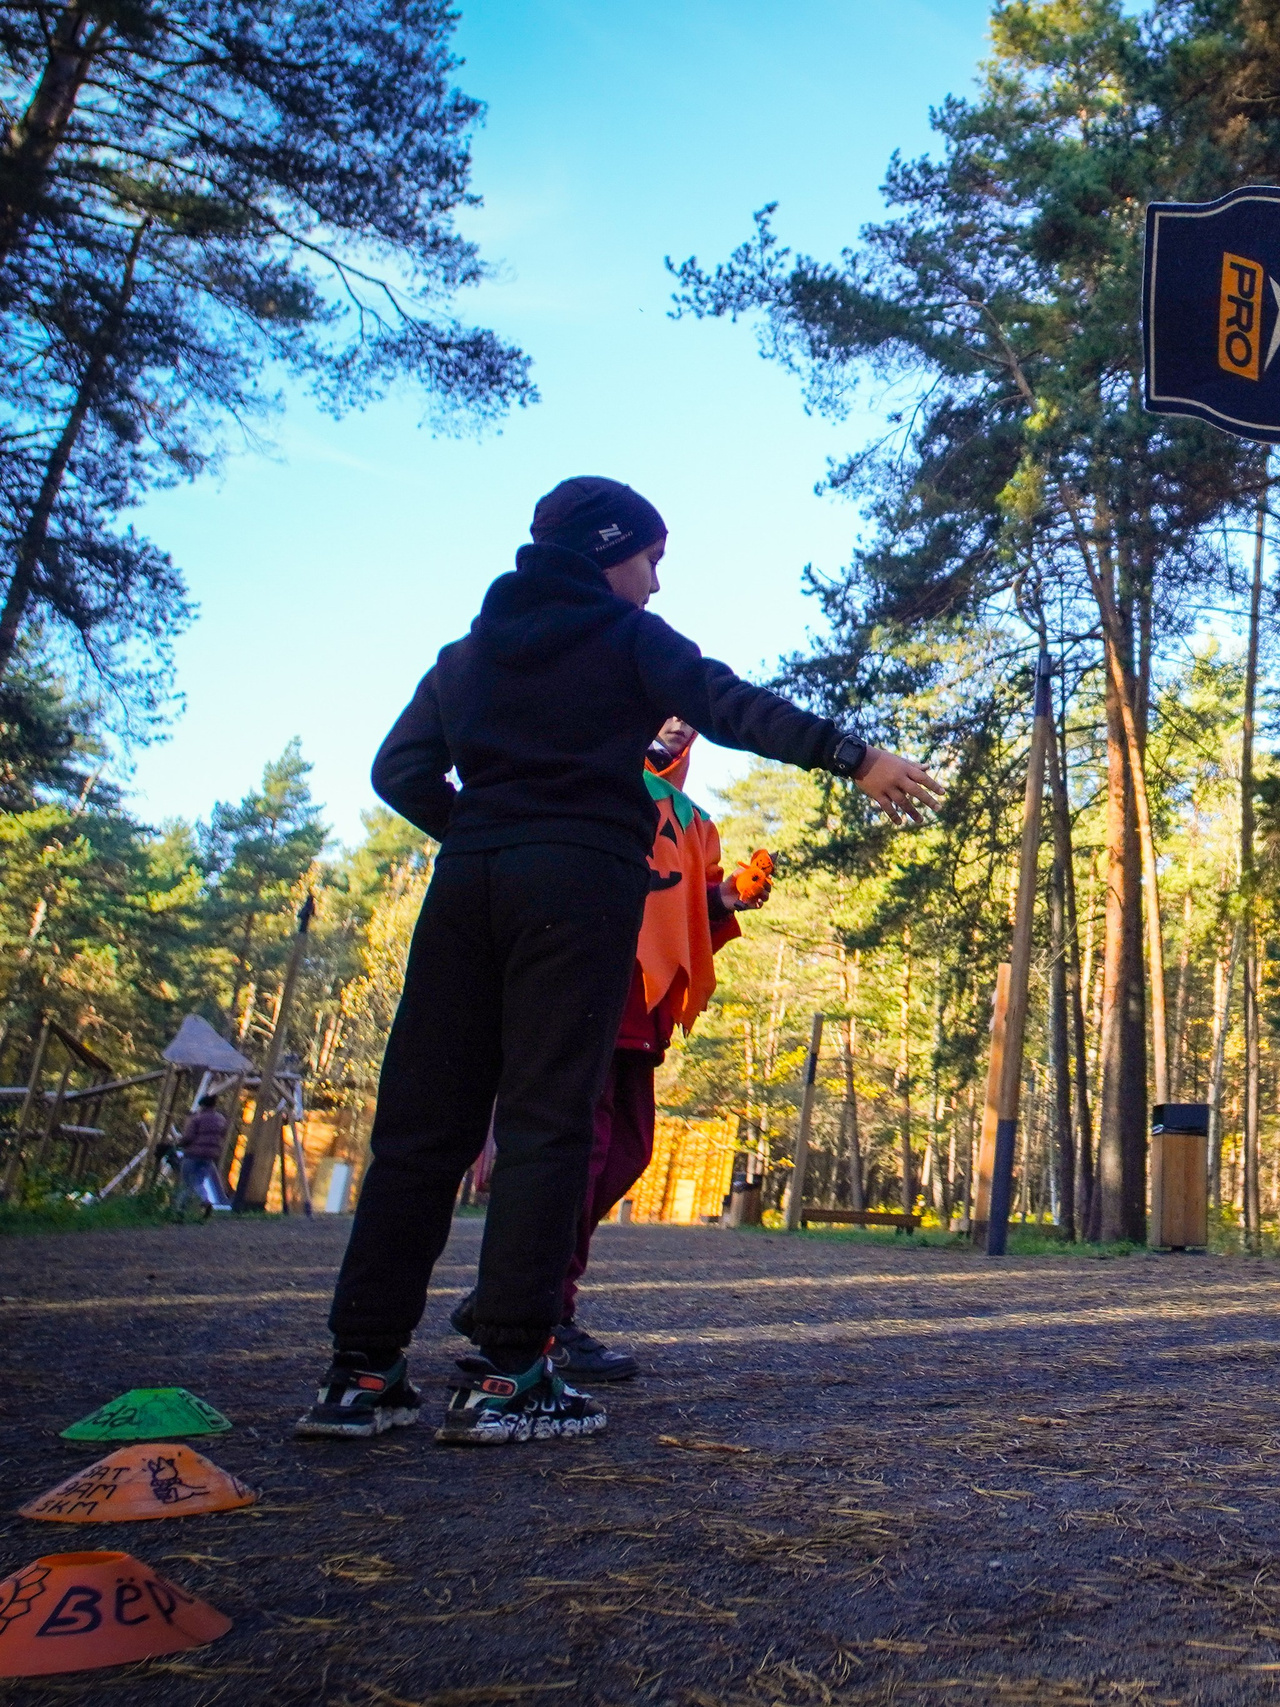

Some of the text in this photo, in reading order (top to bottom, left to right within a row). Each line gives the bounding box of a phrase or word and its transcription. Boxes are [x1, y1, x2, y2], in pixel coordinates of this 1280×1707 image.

[1225, 262, 1256, 367] PRO
[82, 1465, 130, 1480] SAT
[57, 1482, 117, 1499] 9AM
[36, 1500, 99, 1515] 5KM
